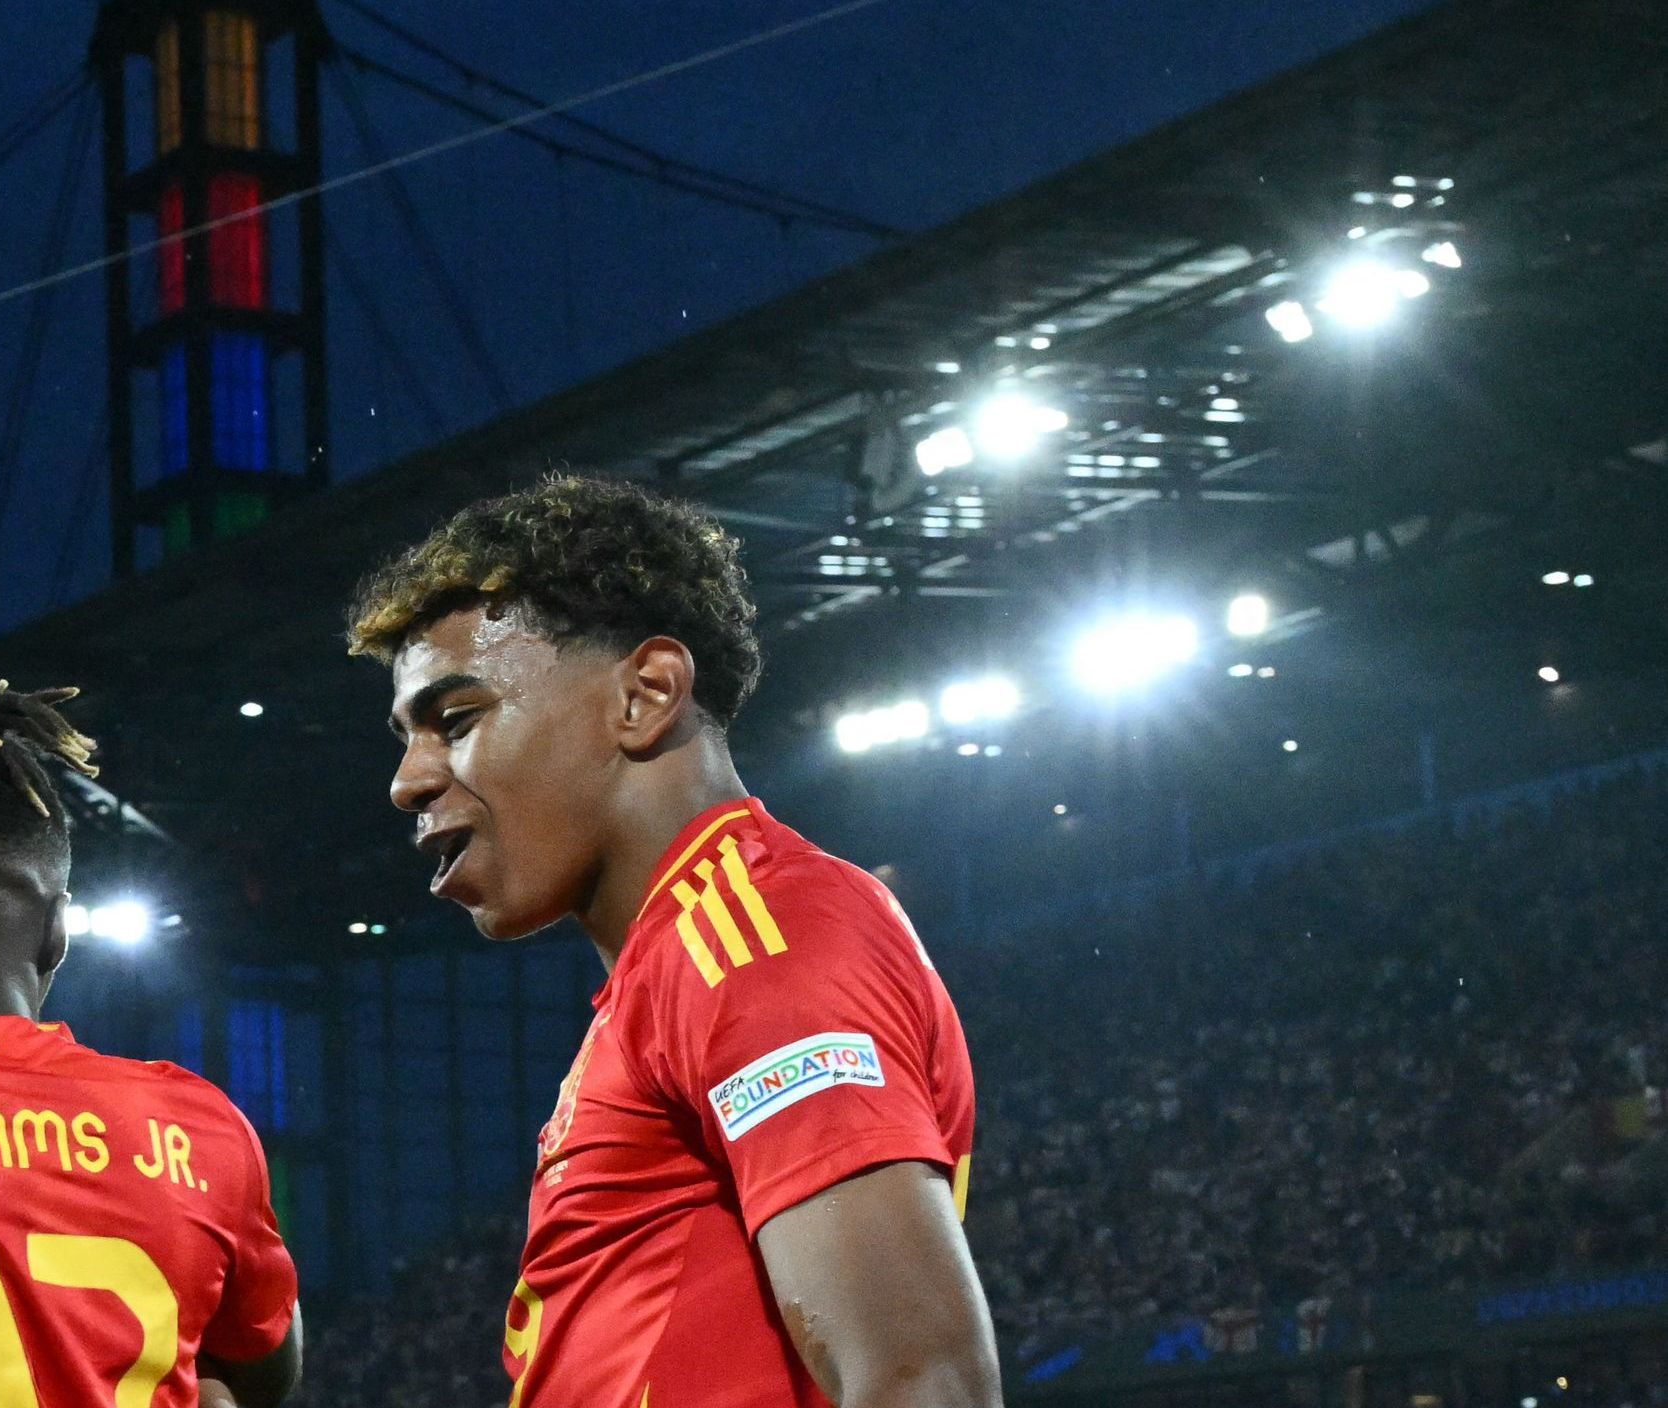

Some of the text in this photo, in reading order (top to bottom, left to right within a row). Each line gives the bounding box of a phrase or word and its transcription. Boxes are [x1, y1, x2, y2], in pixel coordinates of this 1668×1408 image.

[715, 1076, 745, 1103] UEFA
[832, 1069, 846, 1083] for
[134, 1118, 210, 1191] JR.
